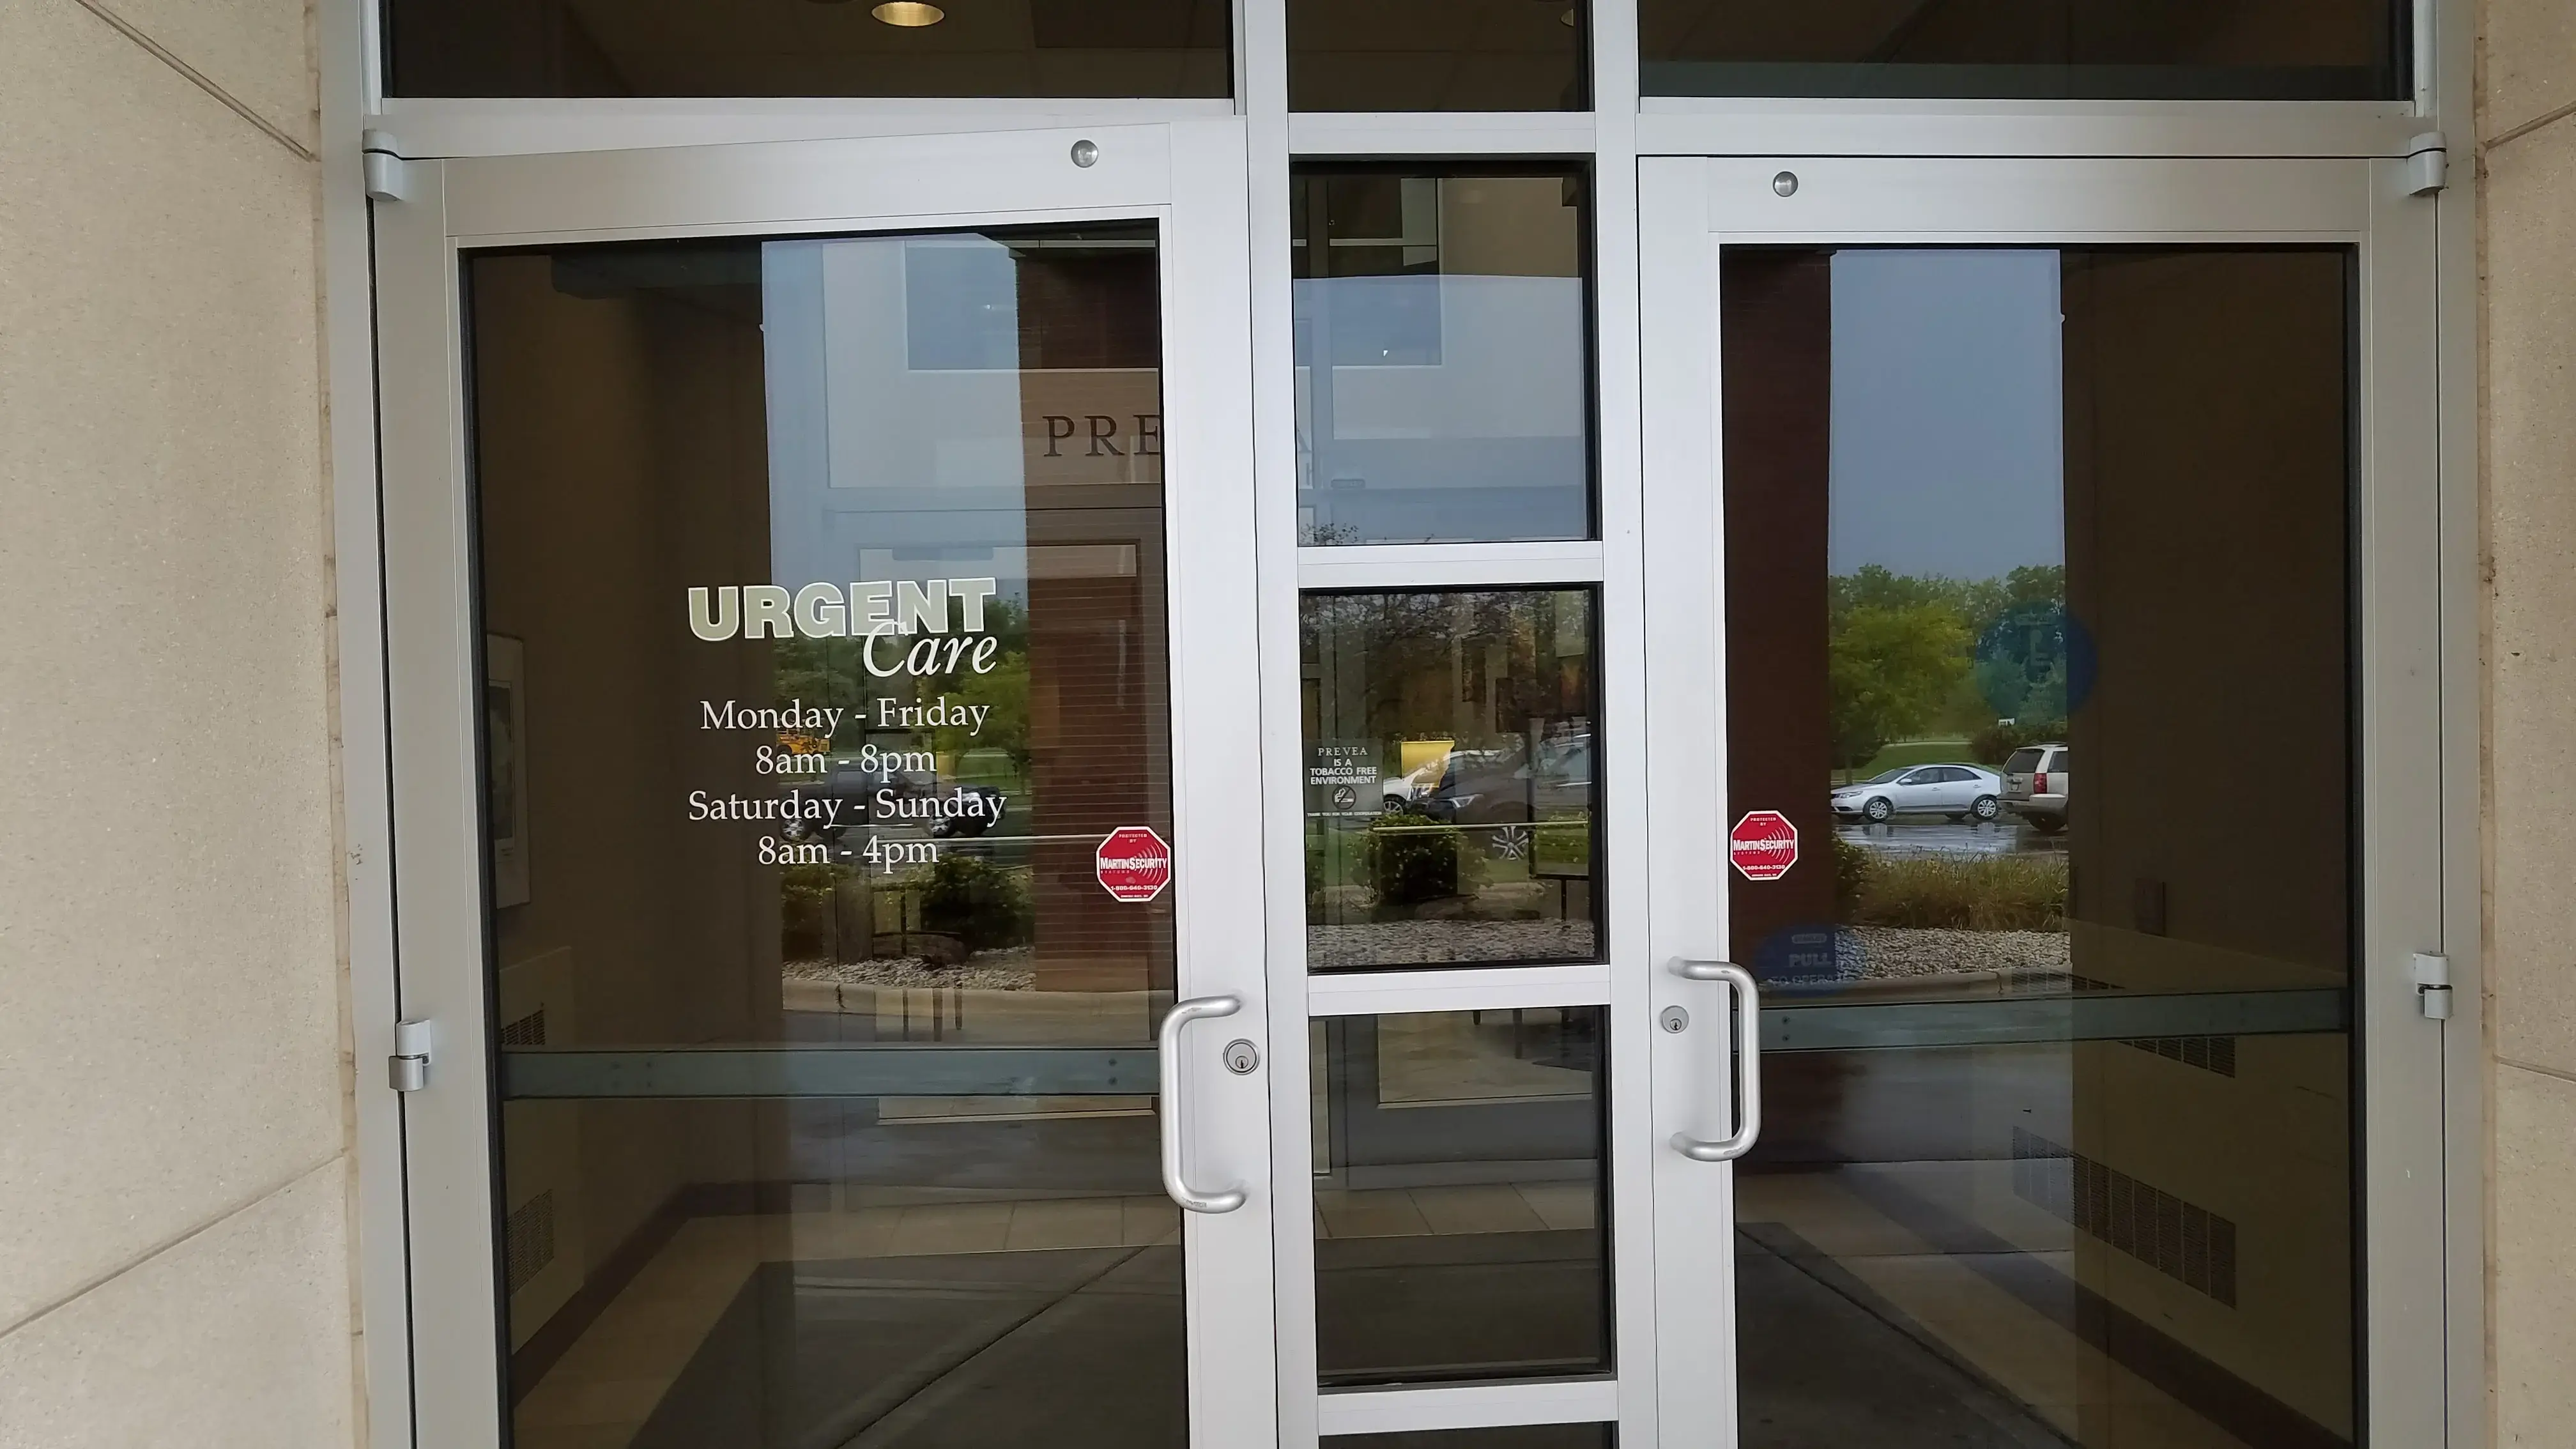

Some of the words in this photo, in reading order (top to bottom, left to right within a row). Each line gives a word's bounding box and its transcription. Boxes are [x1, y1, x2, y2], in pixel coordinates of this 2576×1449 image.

[687, 577, 997, 641] URGENT
[863, 620, 997, 677] Care
[700, 698, 843, 738] Monday
[877, 696, 990, 736] Friday
[756, 746, 828, 774] 8am
[861, 744, 937, 783] 8pm
[1317, 747, 1368, 756] PREVEA
[1333, 758, 1342, 767] IS
[1309, 767, 1353, 776] TOBACCO
[1356, 767, 1377, 775] FREE
[1310, 776, 1377, 785] ENVIRONMENT
[688, 790, 843, 828] Saturday
[876, 786, 1007, 826] Sunday
[758, 836, 830, 864] 8am
[862, 834, 940, 874] 4pm
[1790, 953, 1833, 967] PULL
